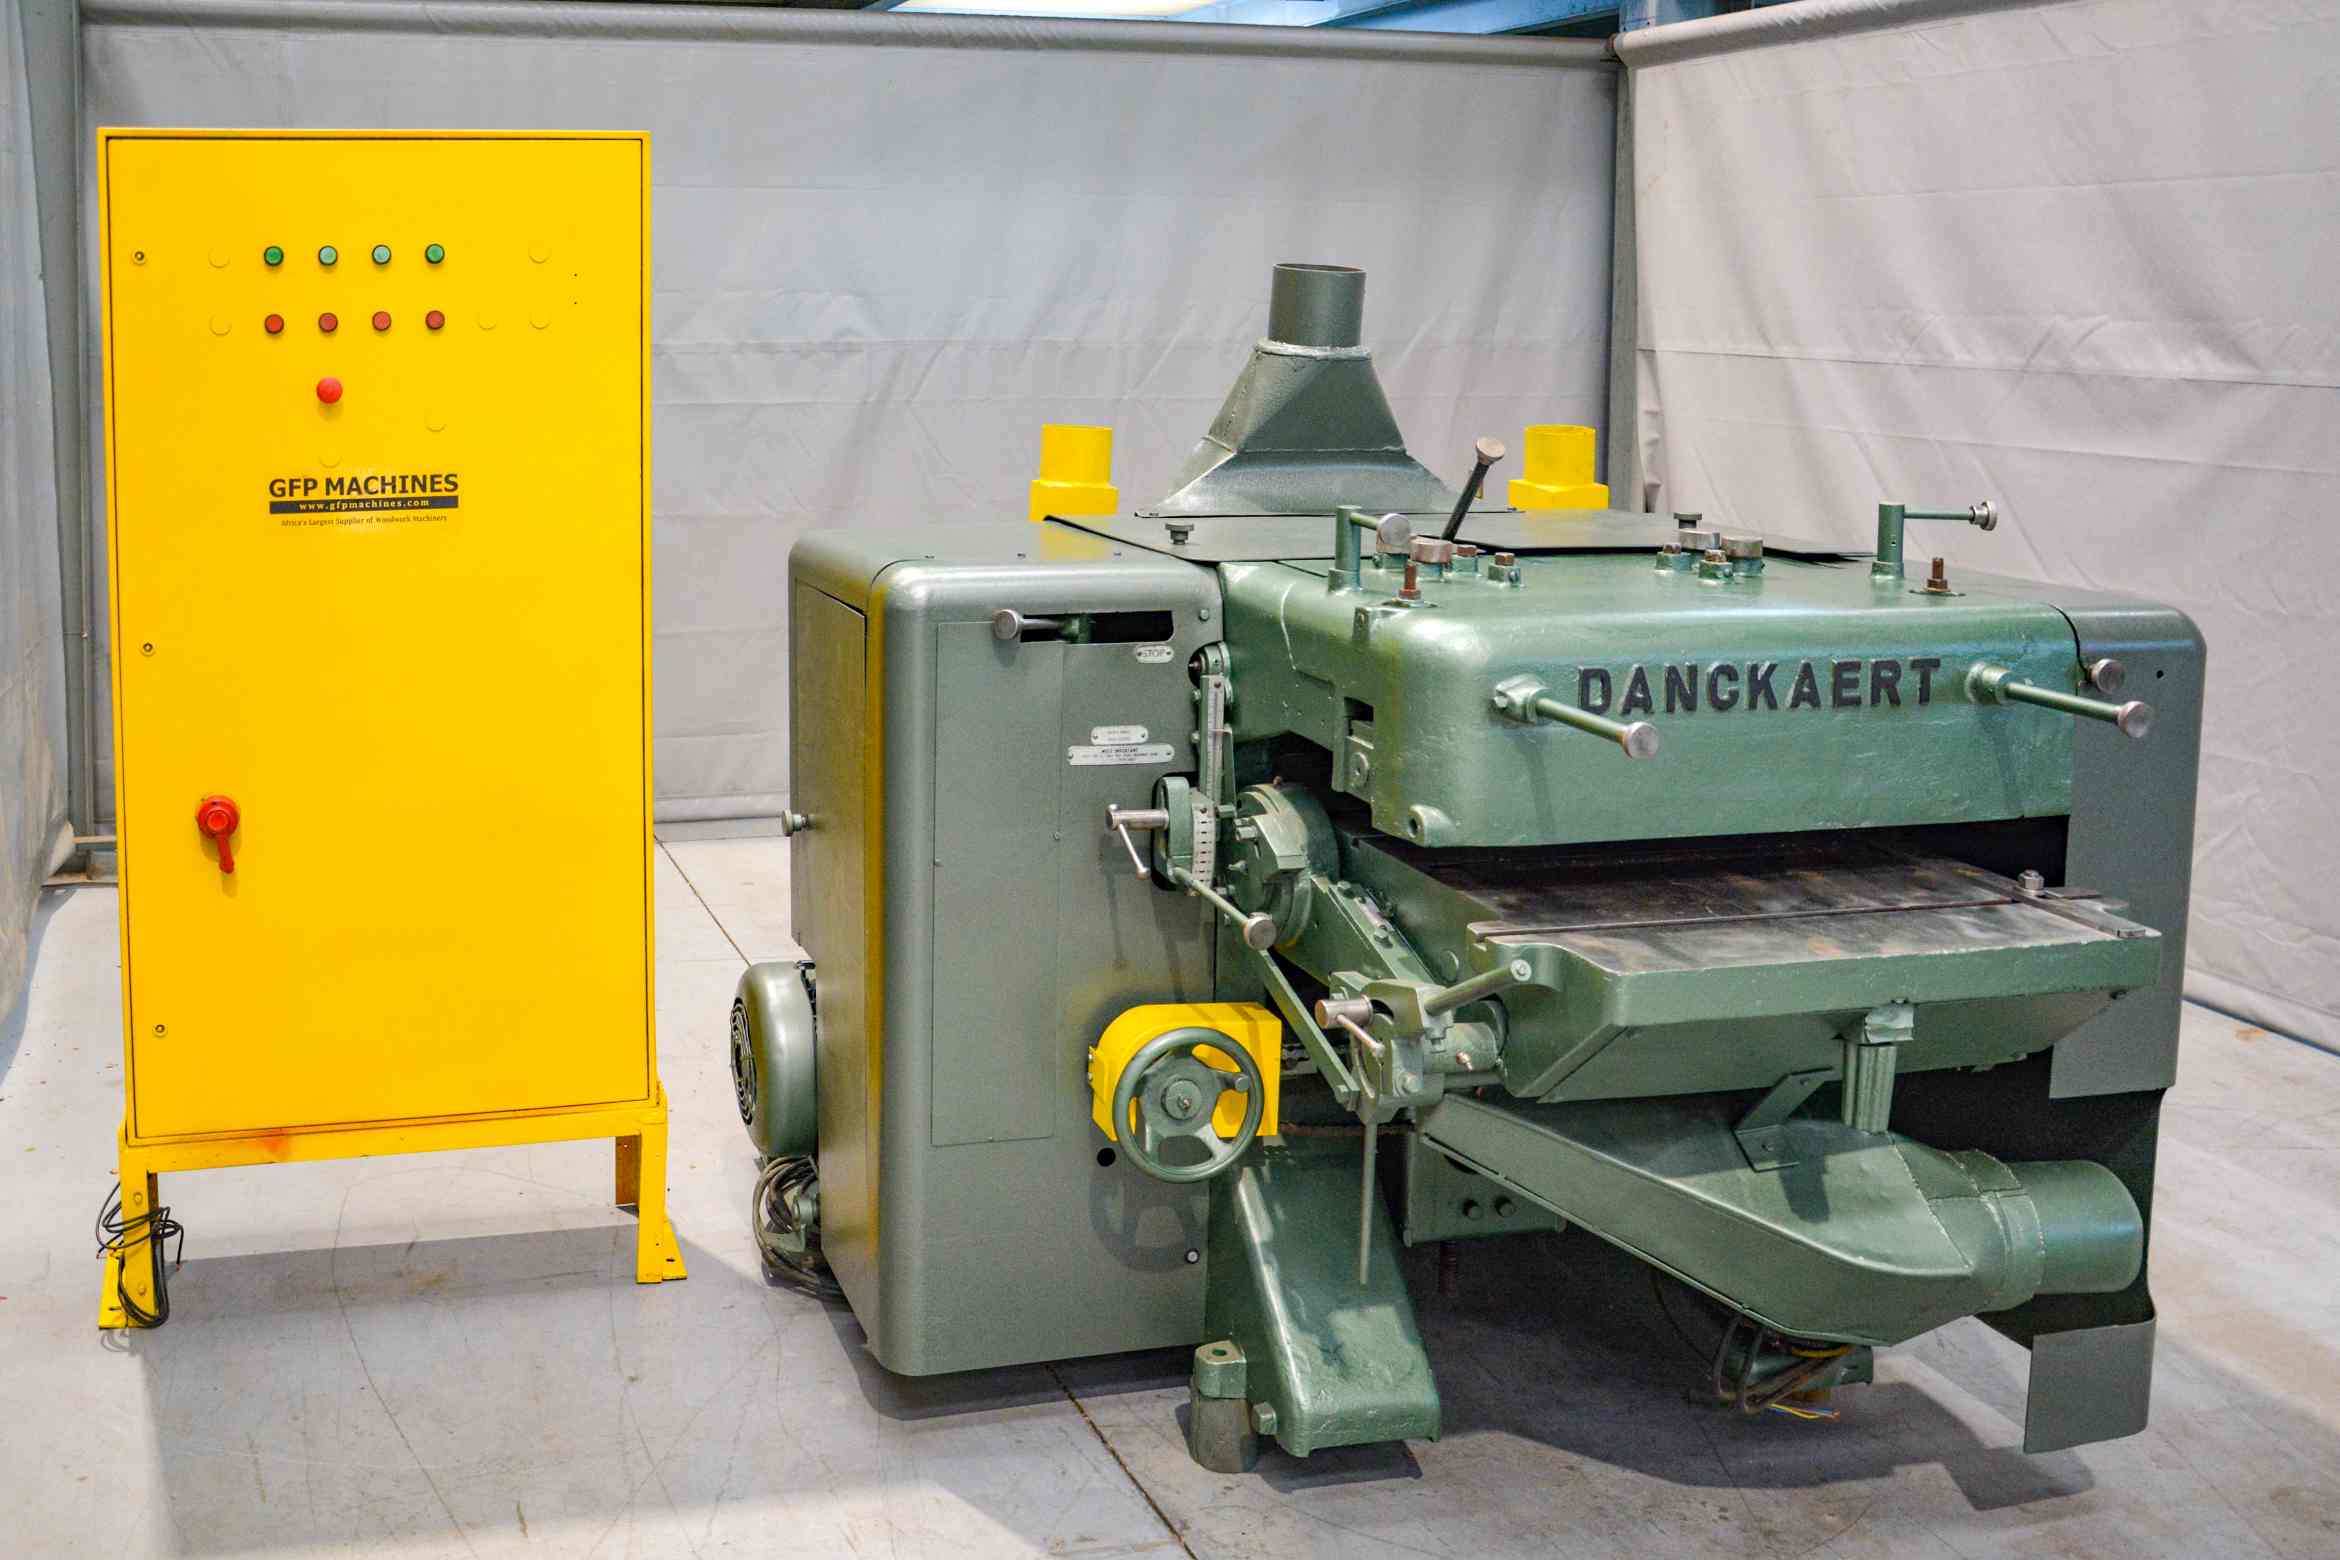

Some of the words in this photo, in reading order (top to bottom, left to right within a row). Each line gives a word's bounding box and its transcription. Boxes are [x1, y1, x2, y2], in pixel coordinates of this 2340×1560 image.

[269, 478, 318, 497] GFP
[325, 473, 458, 496] MACHINES
[299, 499, 430, 512] www.gfpmachines.com
[1142, 649, 1166, 658] STOP
[1578, 656, 1942, 716] DANCKAERT
